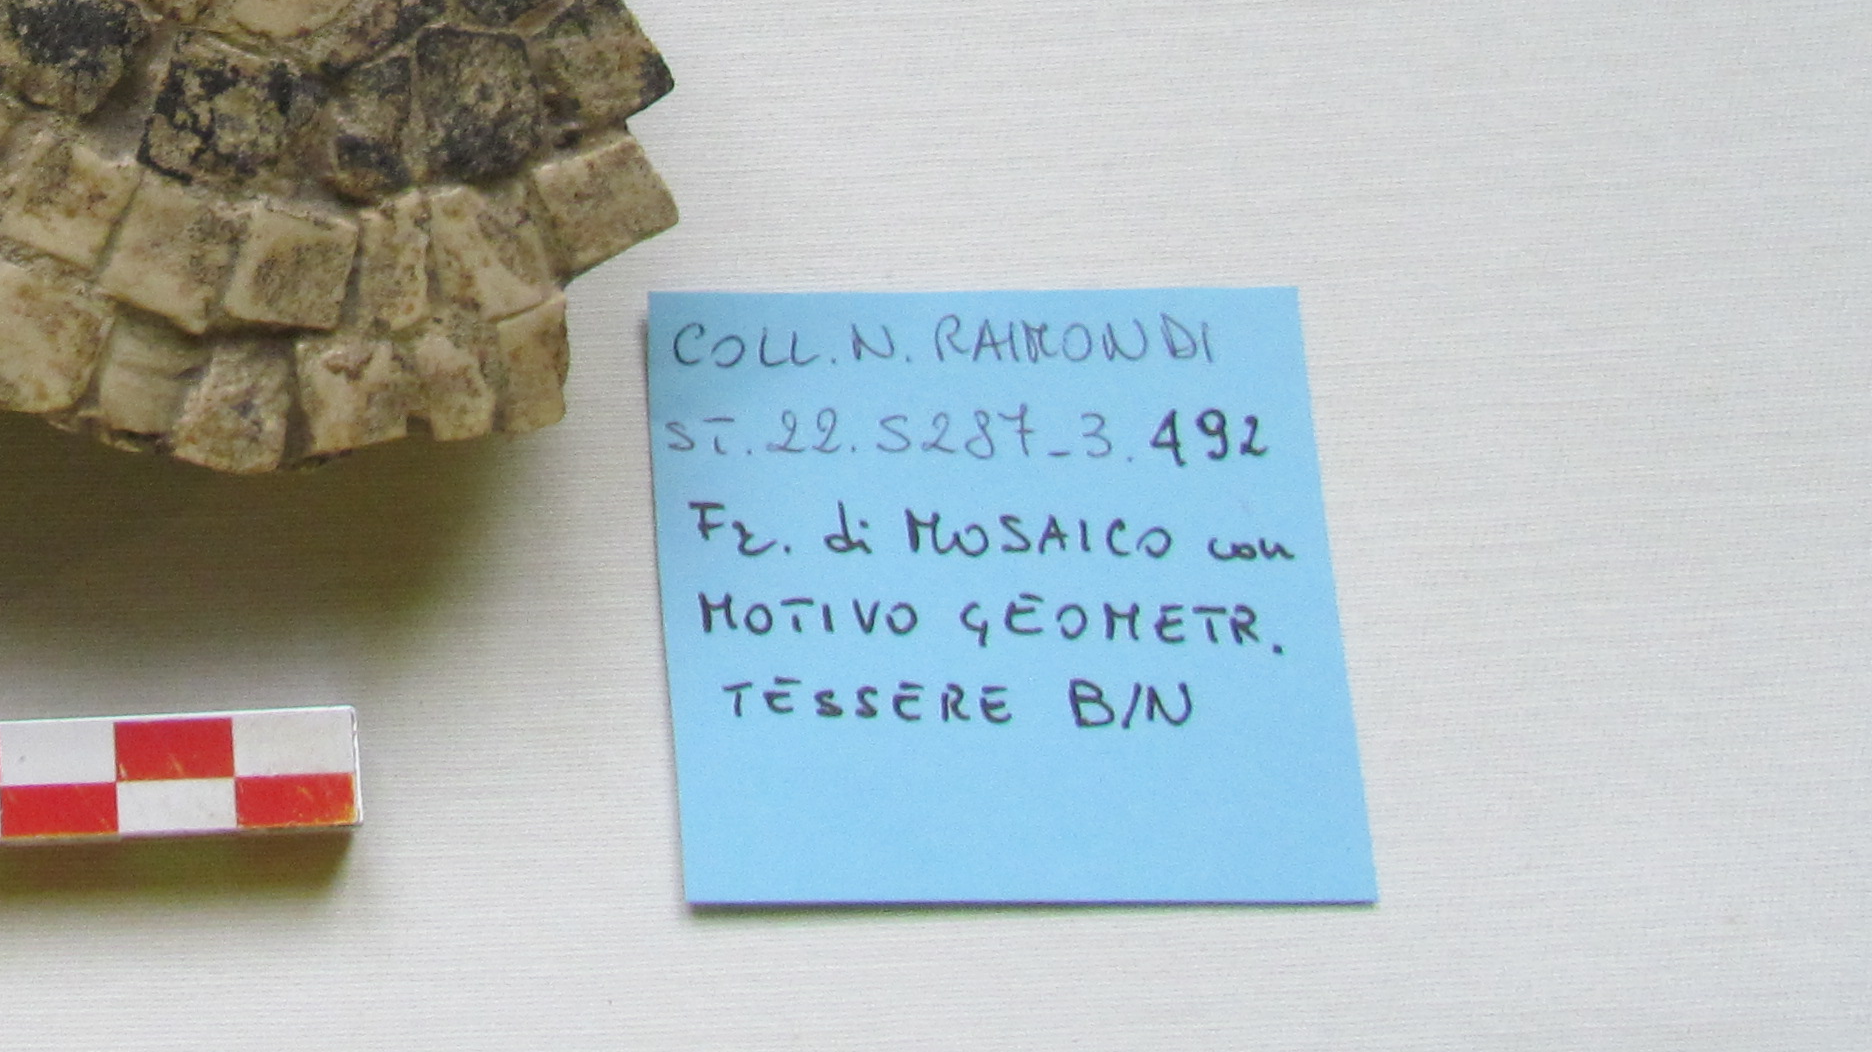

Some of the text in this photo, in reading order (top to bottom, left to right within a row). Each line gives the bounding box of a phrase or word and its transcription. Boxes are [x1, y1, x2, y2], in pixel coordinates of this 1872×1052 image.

[933, 312, 1215, 364] RAIMONDI
[823, 500, 873, 554] di
[904, 507, 1173, 558] MOSAICO
[1207, 536, 1295, 561] con
[697, 591, 1284, 656] MOTIVO GEOMETR.
[722, 675, 1194, 730] TESSERE B/N
